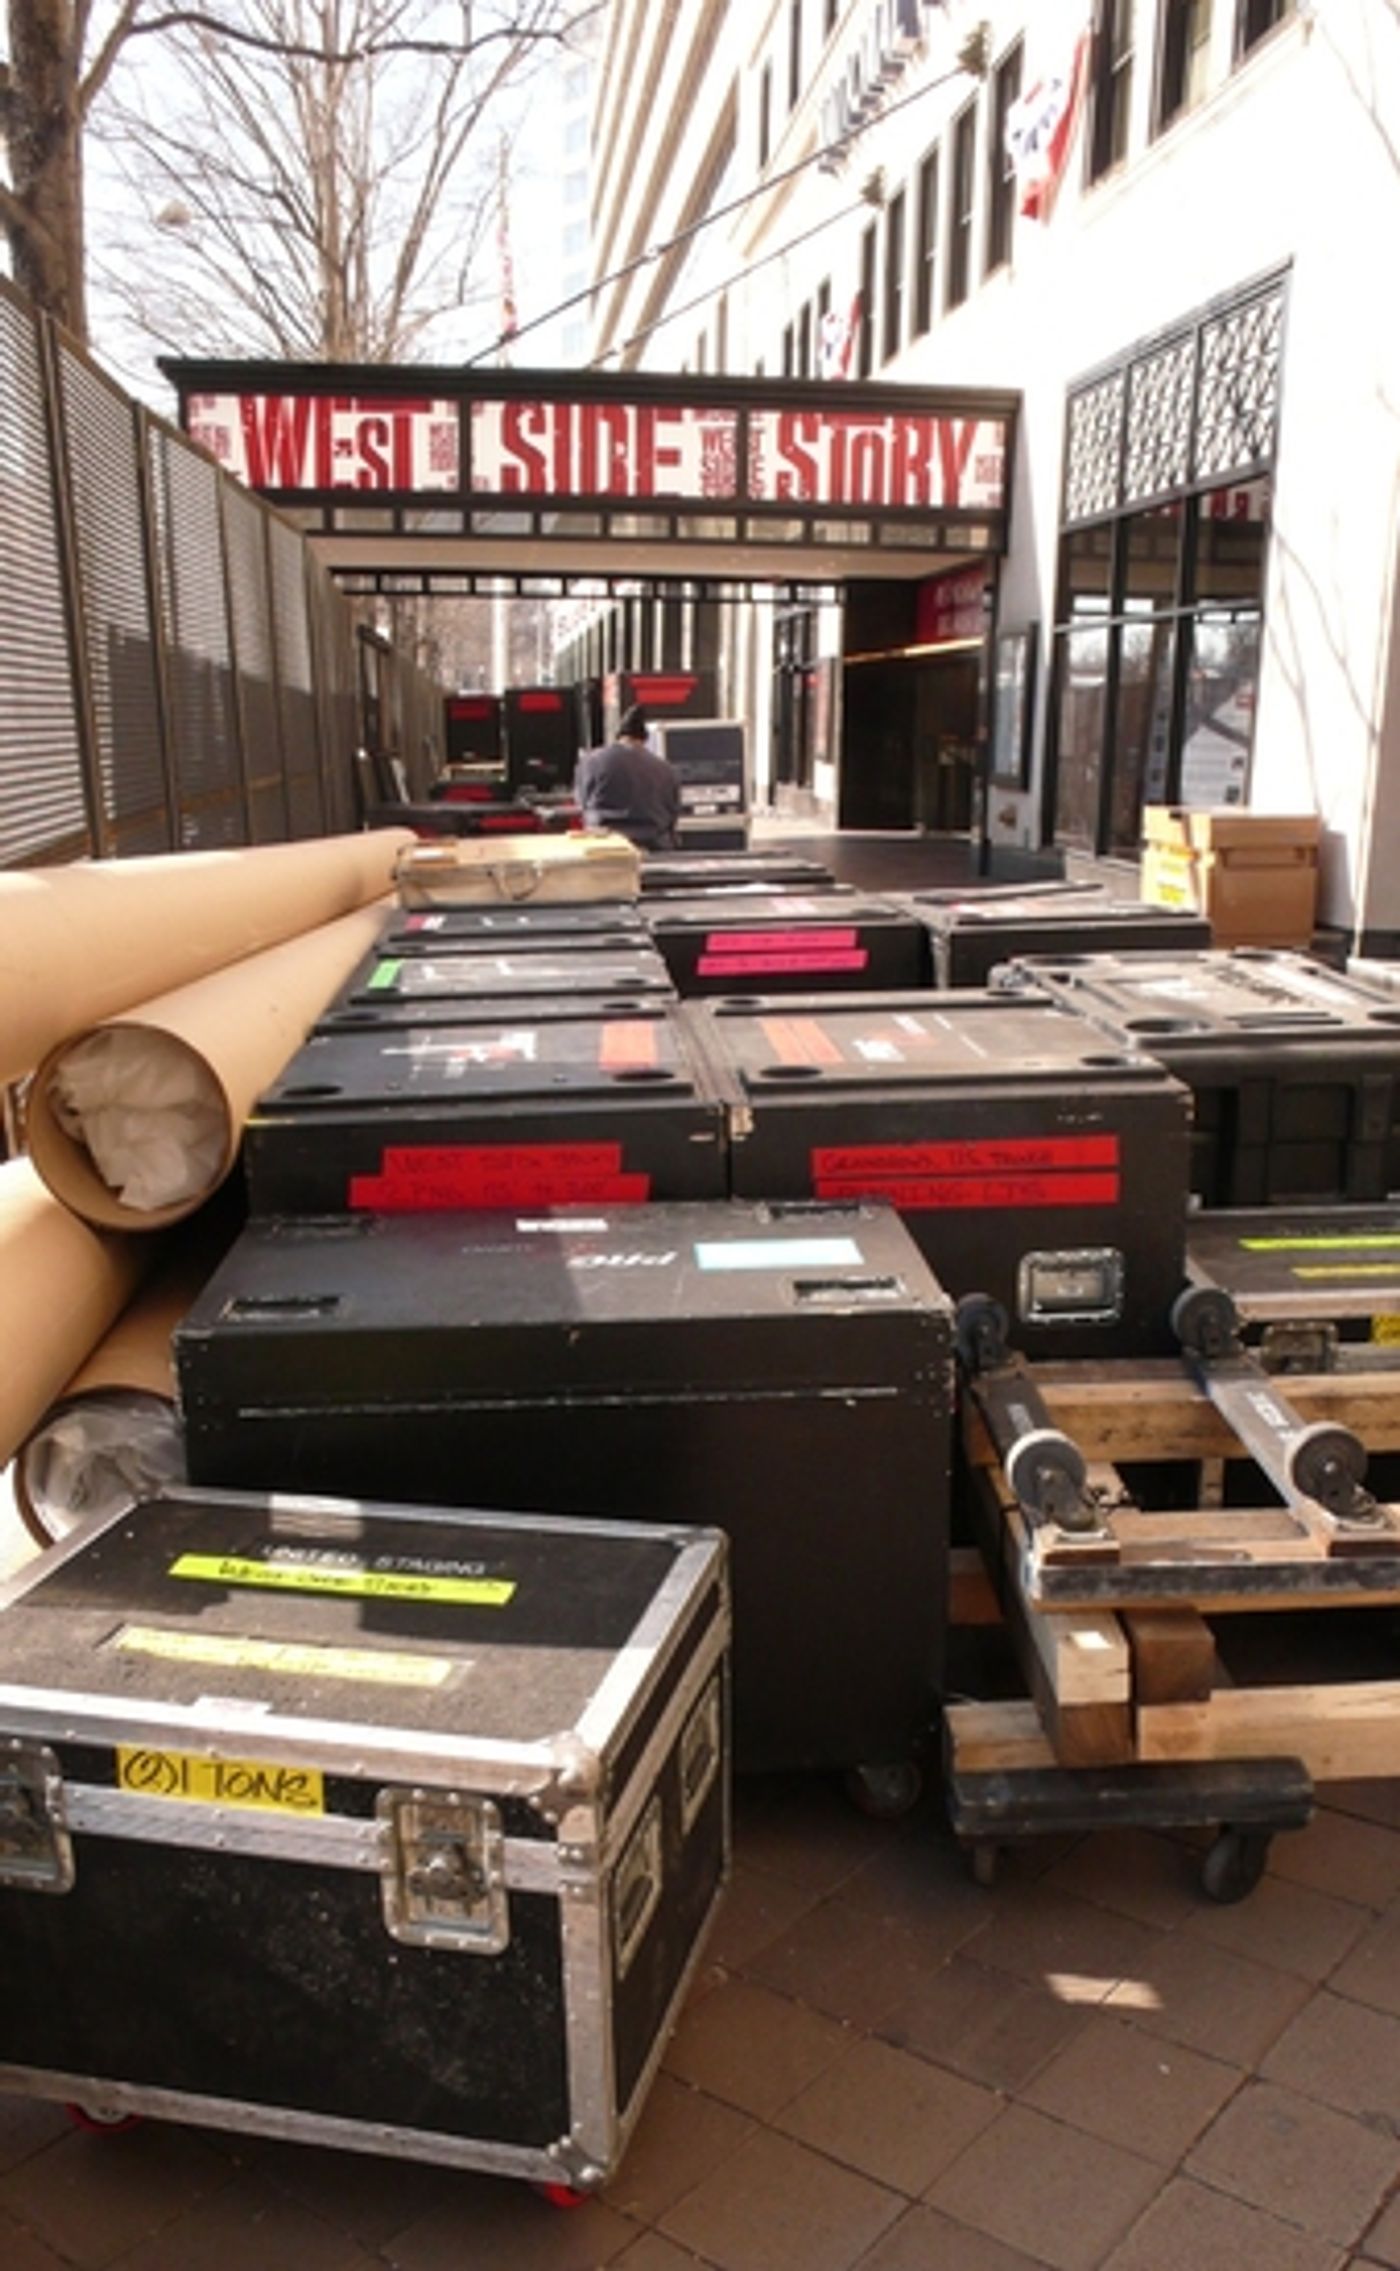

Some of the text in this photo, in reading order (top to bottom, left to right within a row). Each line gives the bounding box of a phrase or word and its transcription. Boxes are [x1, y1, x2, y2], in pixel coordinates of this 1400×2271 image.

[238, 393, 433, 491] WEST
[500, 402, 683, 497] SIDE
[774, 410, 977, 509] STORY
[372, 1553, 488, 1577] STAGING
